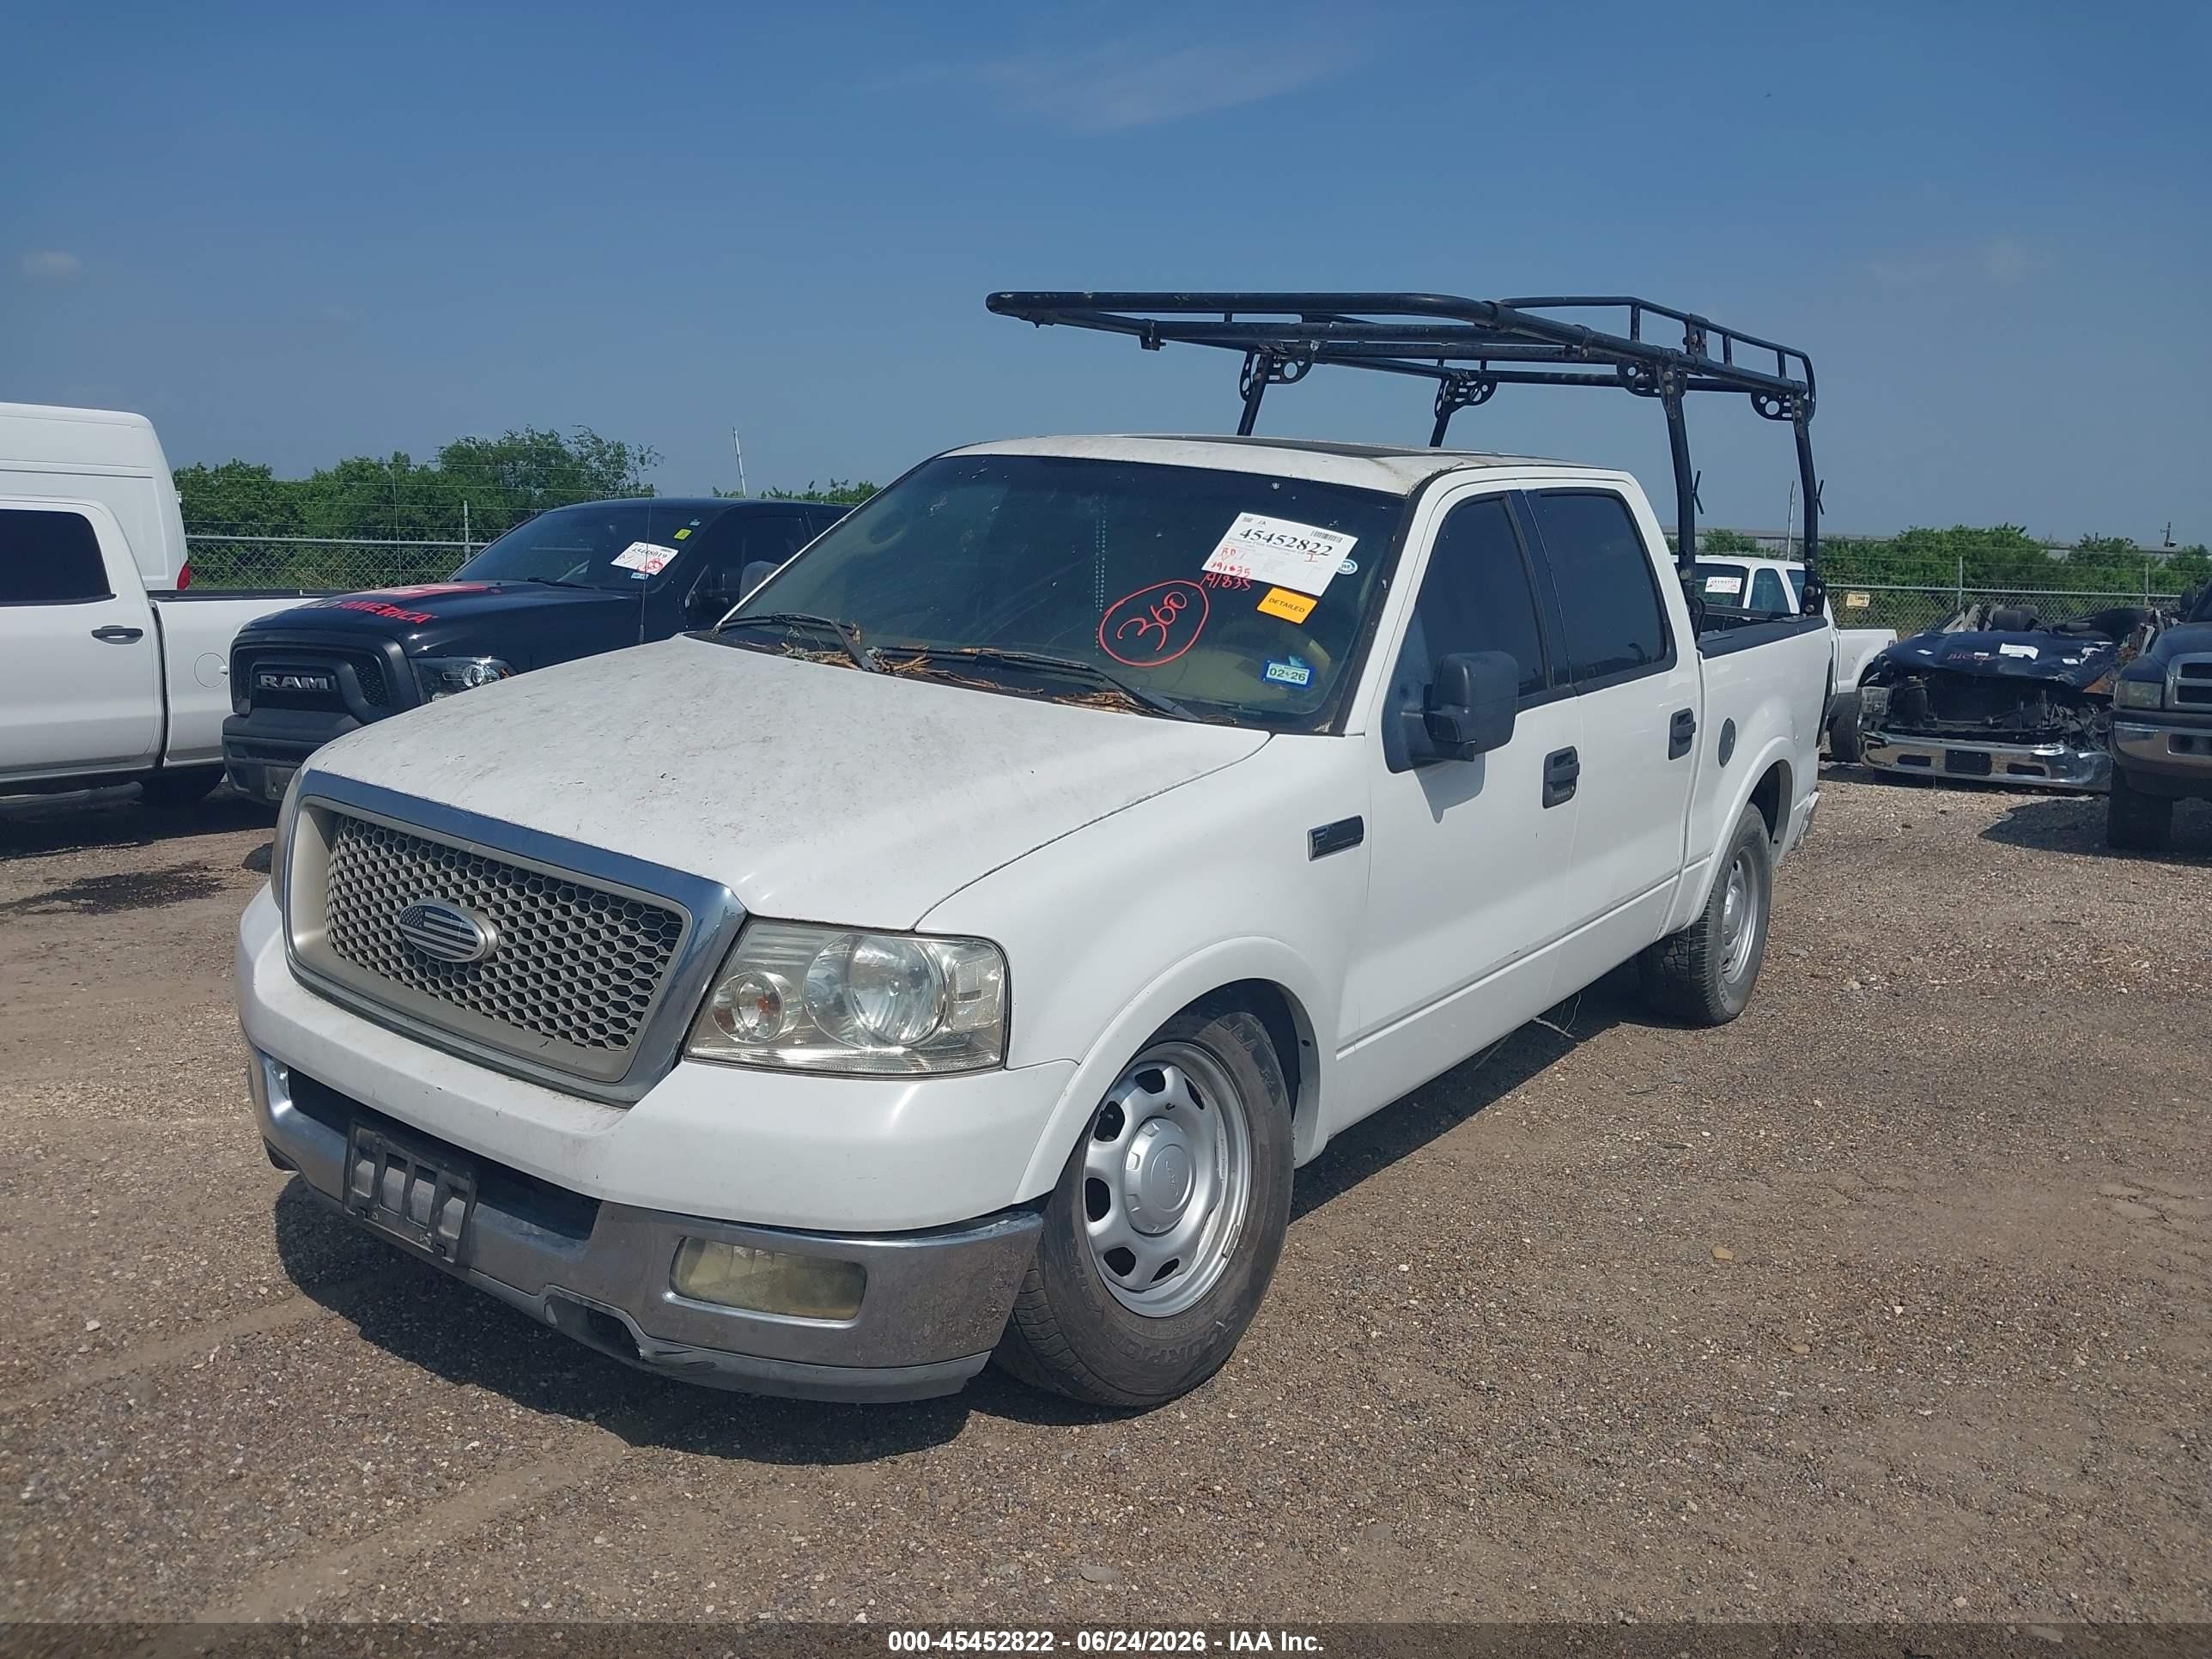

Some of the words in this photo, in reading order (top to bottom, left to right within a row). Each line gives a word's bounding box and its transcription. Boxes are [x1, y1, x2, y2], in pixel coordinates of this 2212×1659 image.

[1239, 527, 1334, 557] 45452822
[1211, 562, 1251, 578] 19135
[336, 600, 431, 624] AMERICA
[1267, 597, 1305, 613] DETAILED
[259, 674, 329, 689] RAM
